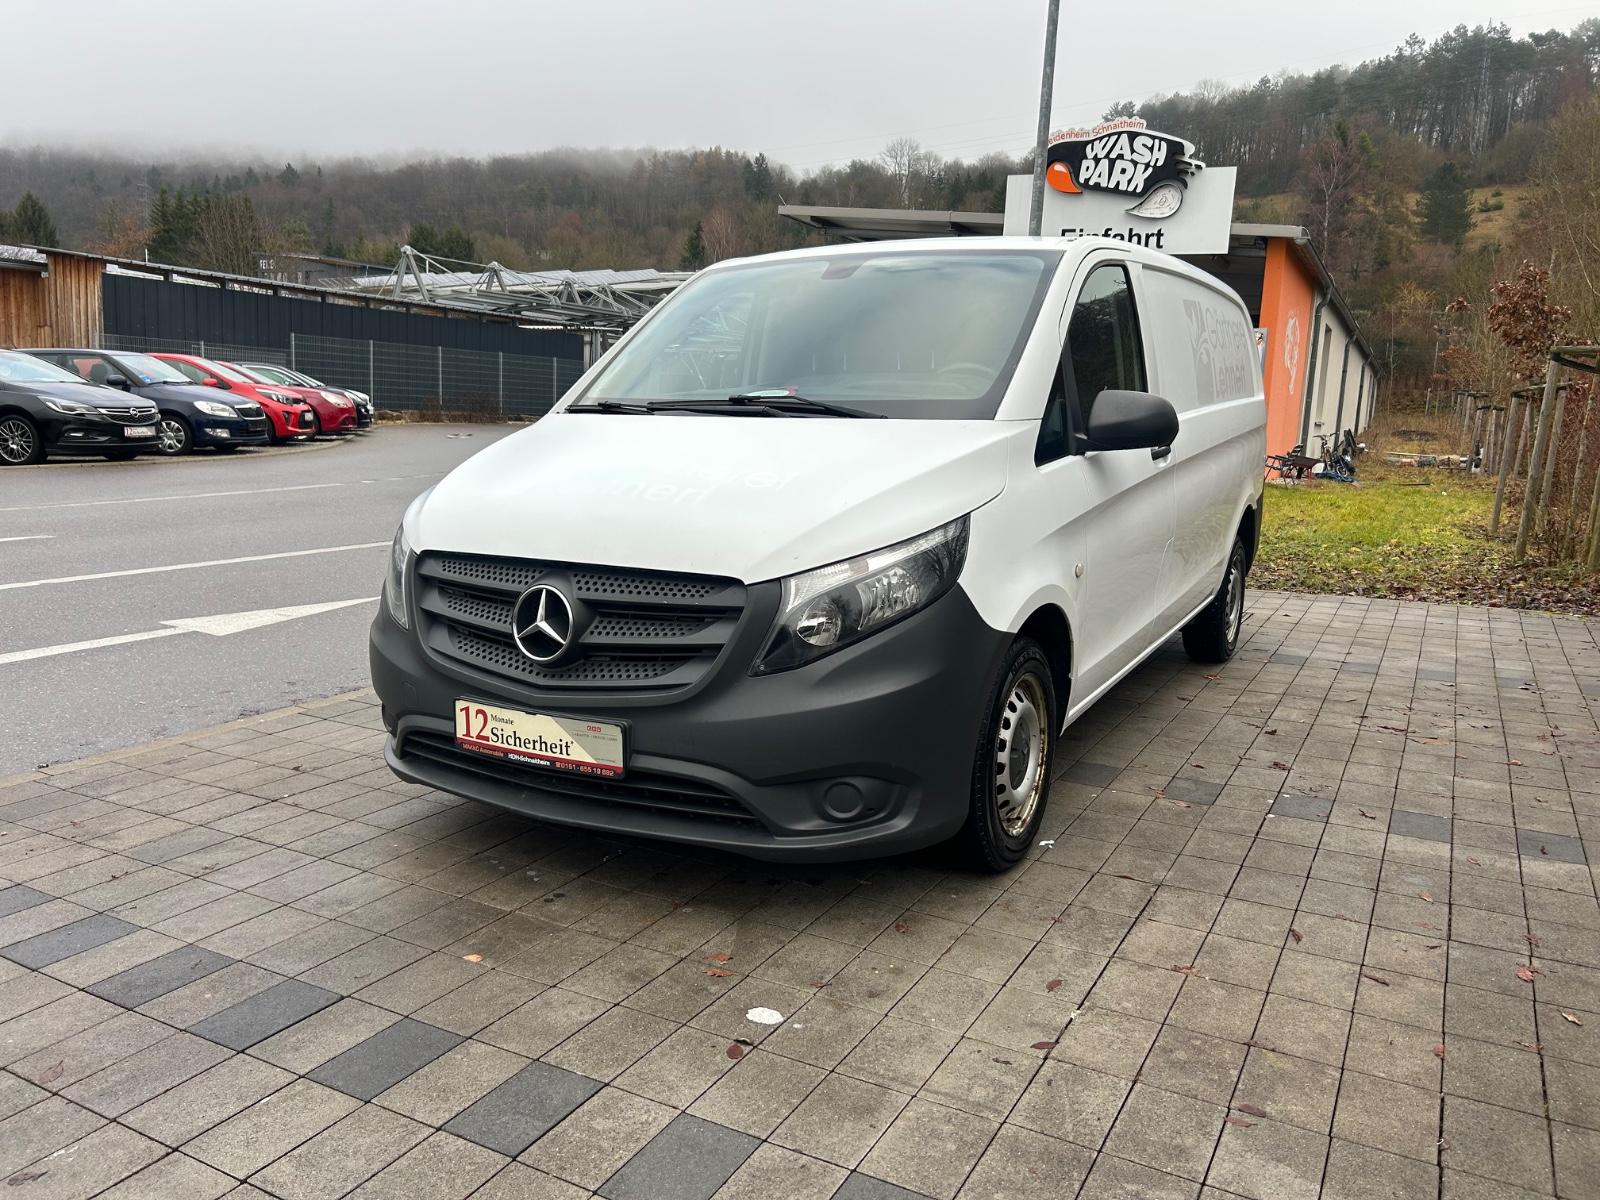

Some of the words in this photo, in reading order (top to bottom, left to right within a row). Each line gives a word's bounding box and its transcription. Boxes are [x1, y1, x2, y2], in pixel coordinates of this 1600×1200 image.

[1048, 130, 1090, 145] eidenheim
[1092, 119, 1145, 137] Schnaitheim
[1085, 133, 1167, 167] WASH
[1078, 159, 1153, 193] PARK
[1061, 228, 1164, 249] fhrt
[459, 705, 490, 742] 12
[490, 714, 514, 726] Monate
